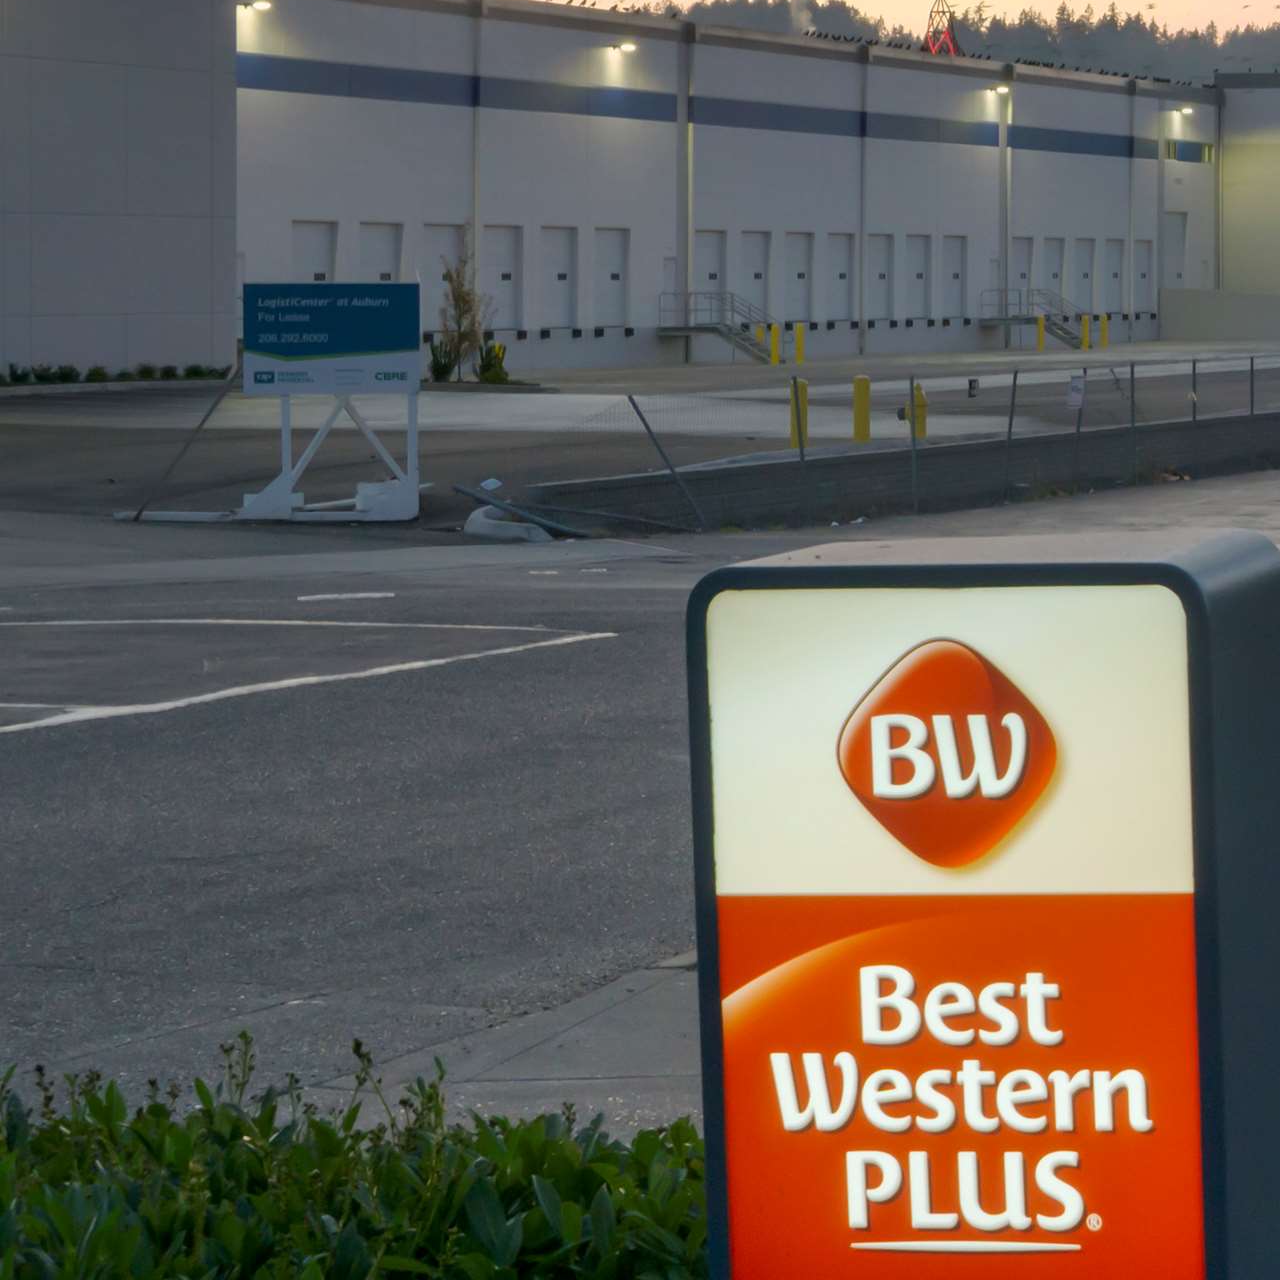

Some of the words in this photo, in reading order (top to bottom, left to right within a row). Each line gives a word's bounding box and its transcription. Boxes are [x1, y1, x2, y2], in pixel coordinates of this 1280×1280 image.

[257, 312, 275, 322] For
[336, 298, 348, 307] at
[351, 297, 390, 307] Auburn
[374, 372, 408, 381] CBRE
[869, 712, 1028, 799] BW
[859, 964, 1063, 1047] Best
[769, 1051, 1153, 1133] Western
